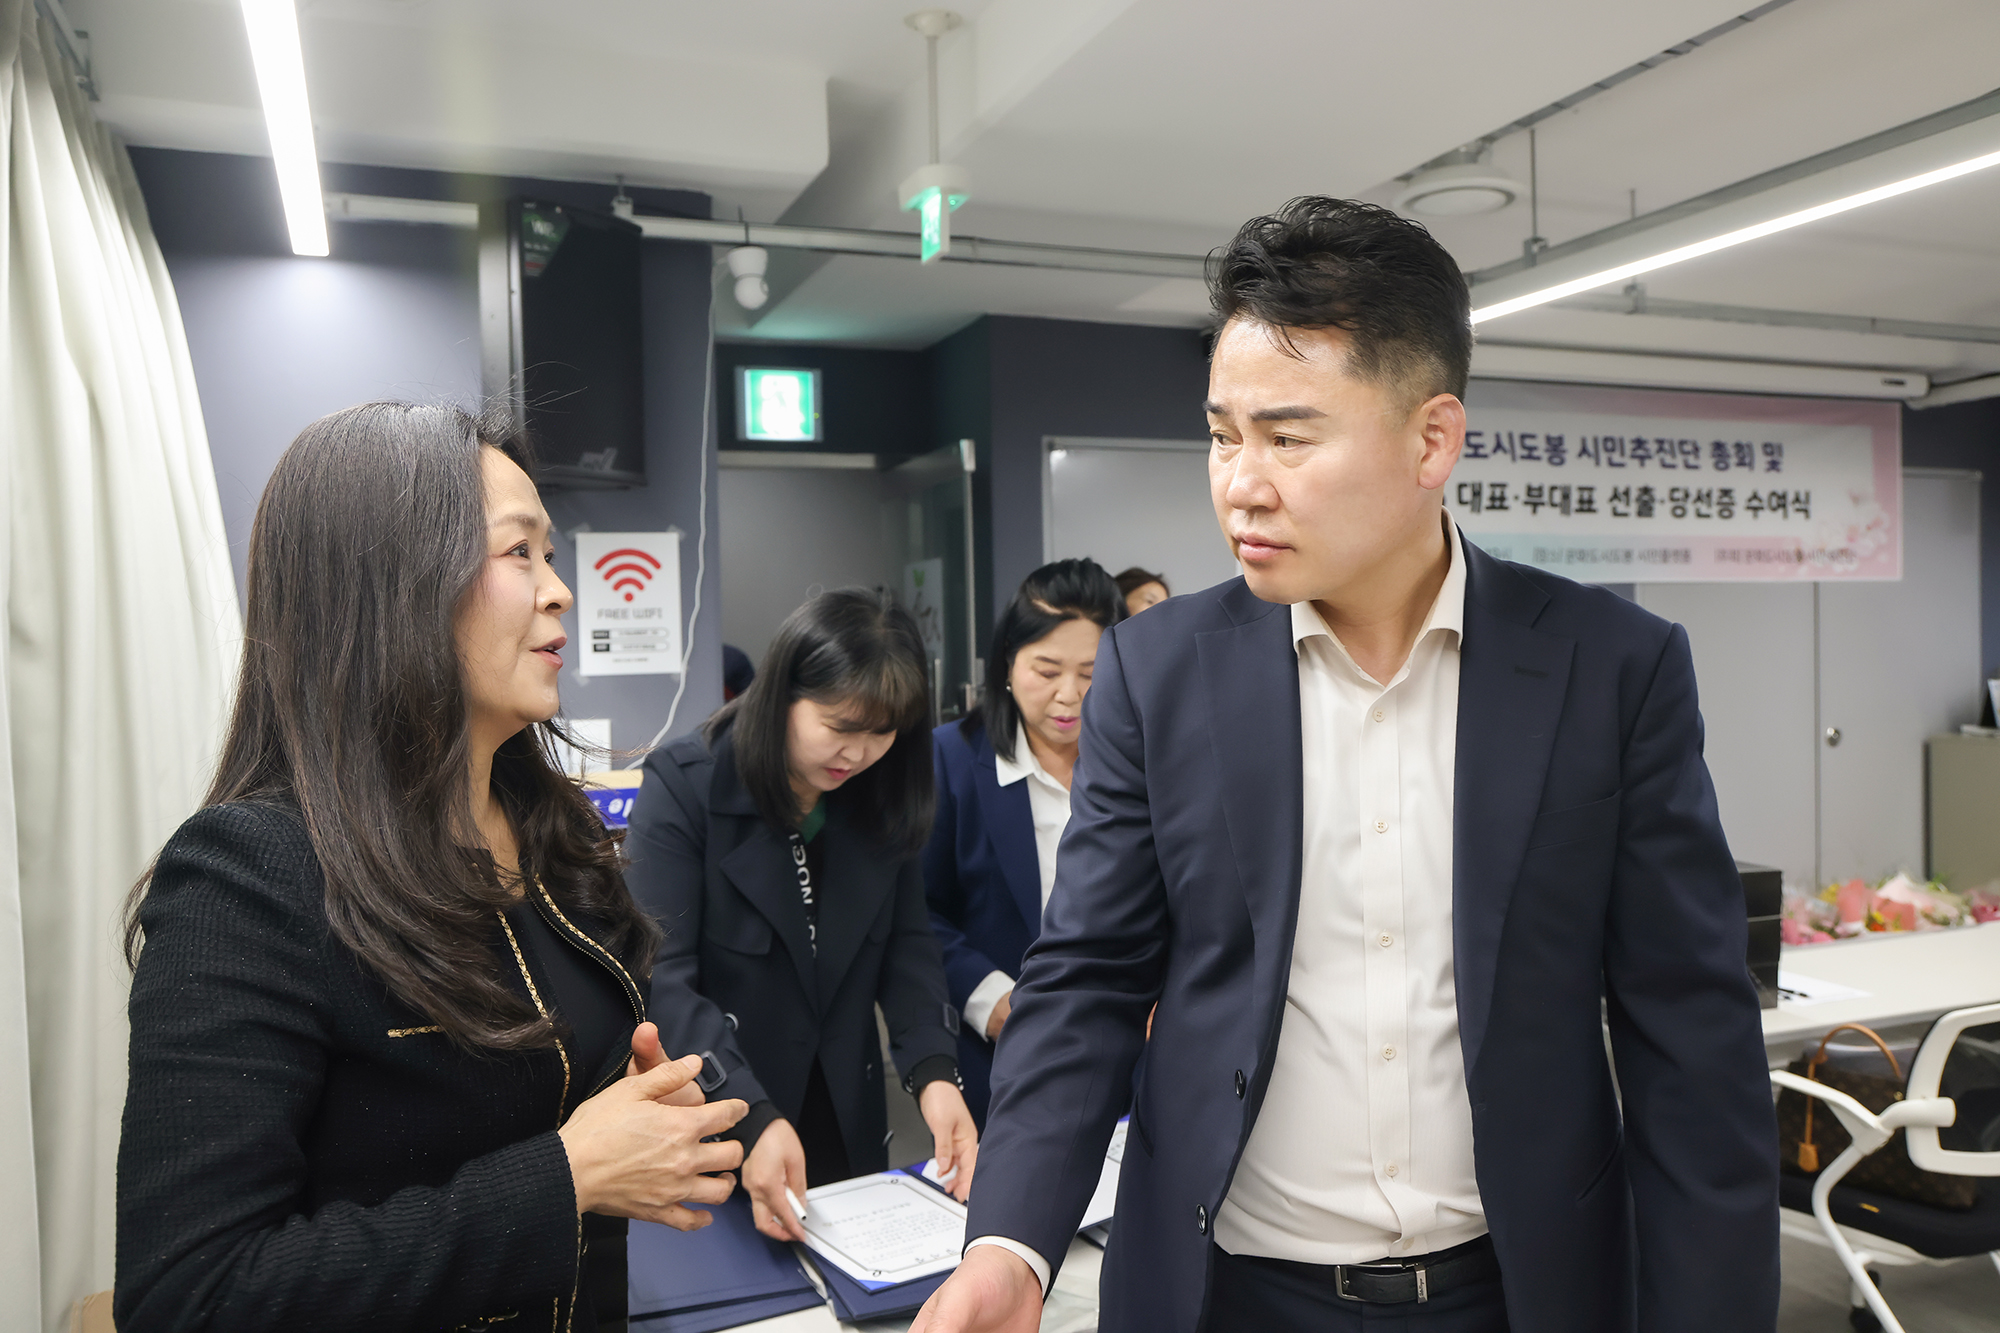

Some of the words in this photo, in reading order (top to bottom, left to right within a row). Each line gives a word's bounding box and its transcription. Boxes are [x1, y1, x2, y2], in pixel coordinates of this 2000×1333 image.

[1457, 431, 1567, 467] 도시도봉
[1578, 436, 1700, 470] 시민추진단
[1710, 440, 1755, 472] 총회
[1761, 442, 1784, 473] 및
[1457, 482, 1598, 516] 대표·부대표
[1609, 486, 1735, 519] 선출·당선증
[1745, 490, 1811, 520] 수여식
[597, 607, 630, 620] FREE
[632, 607, 663, 620] WIFI
